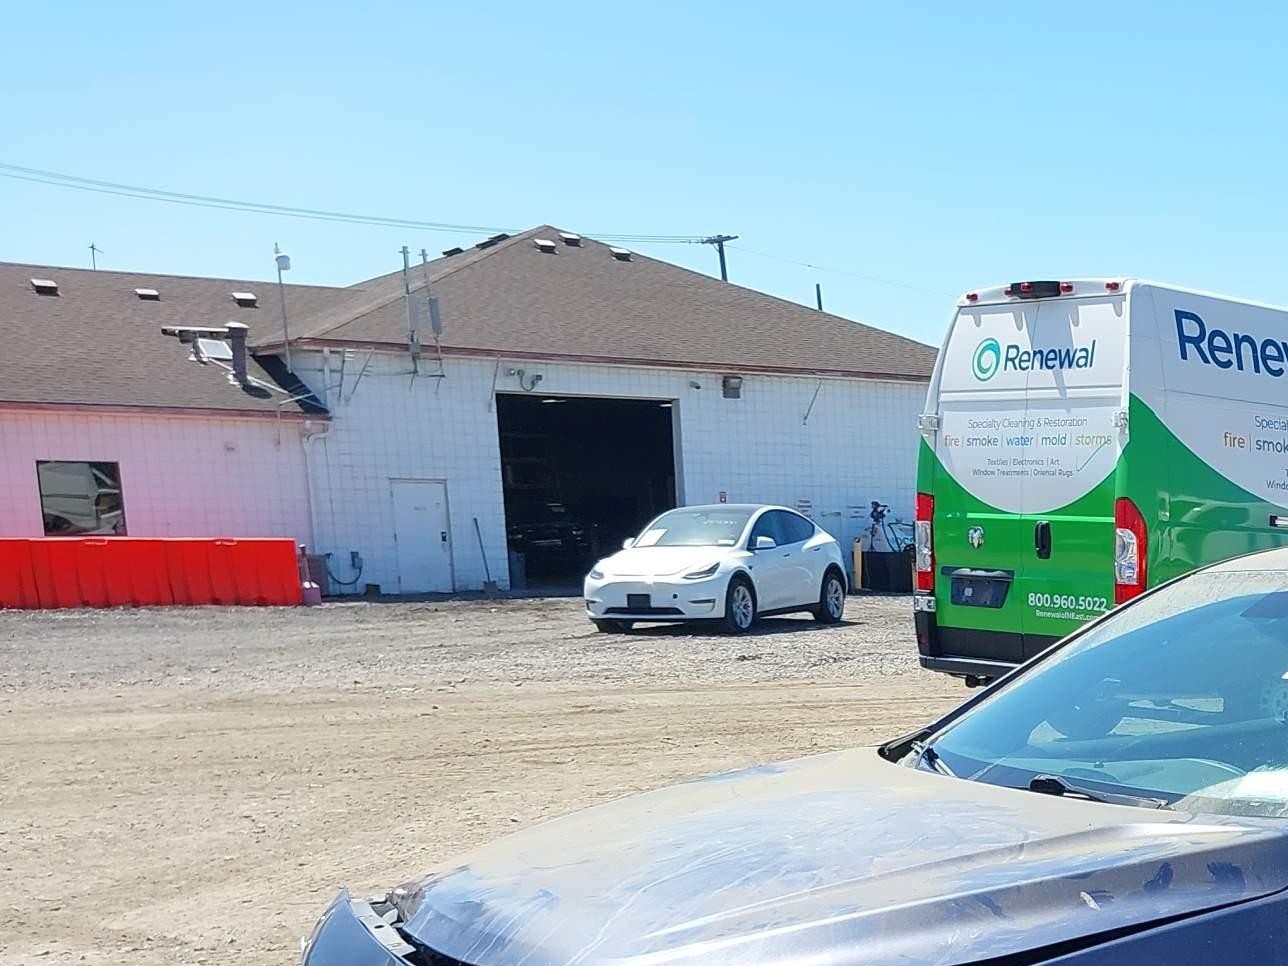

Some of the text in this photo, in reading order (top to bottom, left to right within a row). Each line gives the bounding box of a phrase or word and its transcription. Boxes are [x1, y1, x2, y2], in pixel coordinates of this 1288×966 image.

[1003, 339, 1097, 372] Renewal
[968, 418, 1088, 430] Specialty Cleaning & Restoration
[944, 434, 1113, 447] fire smoke water mold storms
[1224, 432, 1246, 448] fire
[1012, 458, 1044, 466] Electronics
[1050, 458, 1060, 466] Art
[1028, 592, 1107, 611] 800.960.5022
